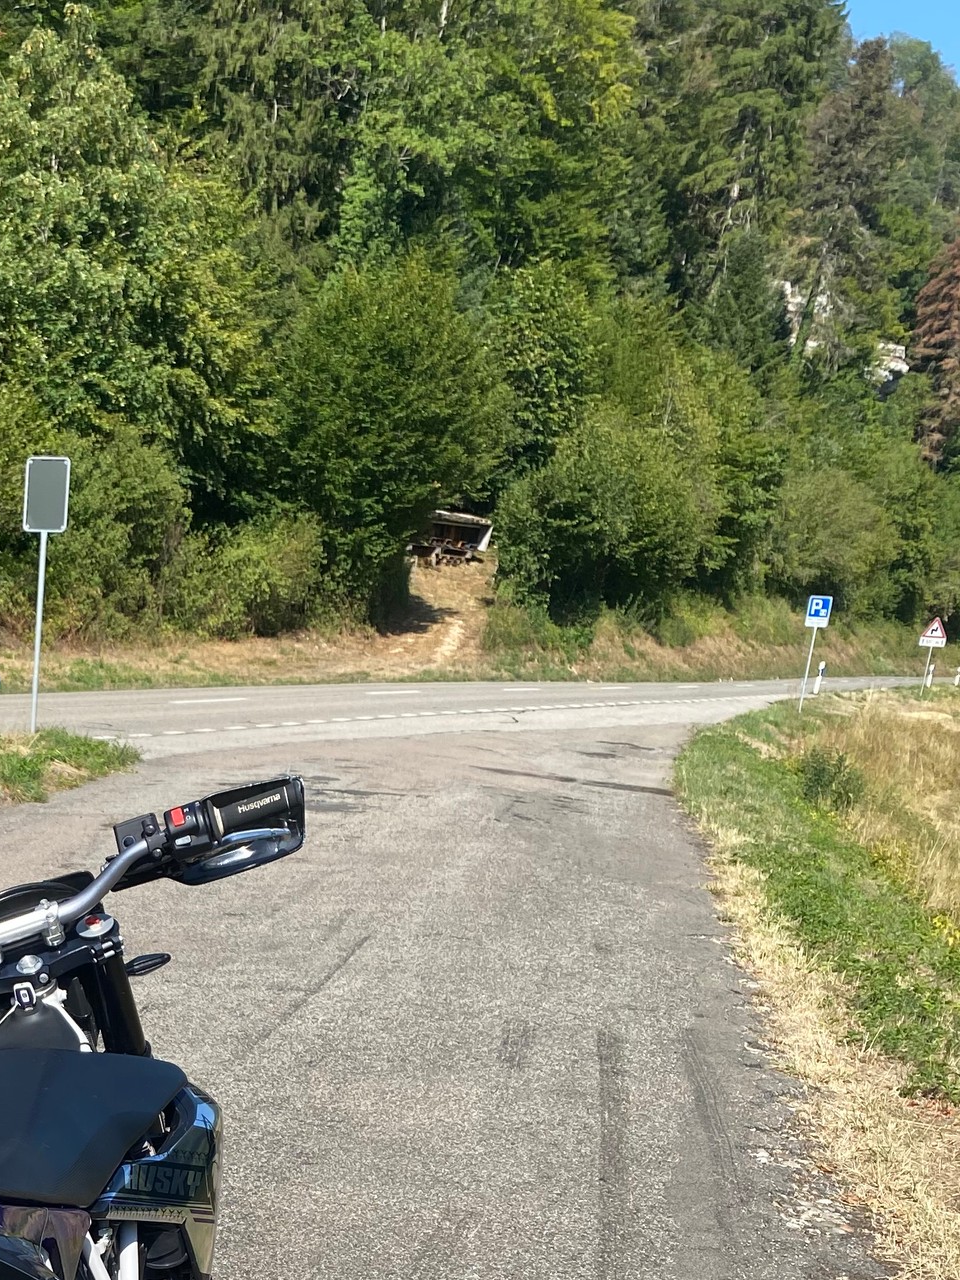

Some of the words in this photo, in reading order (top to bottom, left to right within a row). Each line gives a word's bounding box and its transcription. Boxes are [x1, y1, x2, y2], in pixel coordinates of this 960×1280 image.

[810, 599, 823, 615] P
[238, 792, 281, 813] Husqvarna
[122, 1164, 202, 1198] HUSKY
